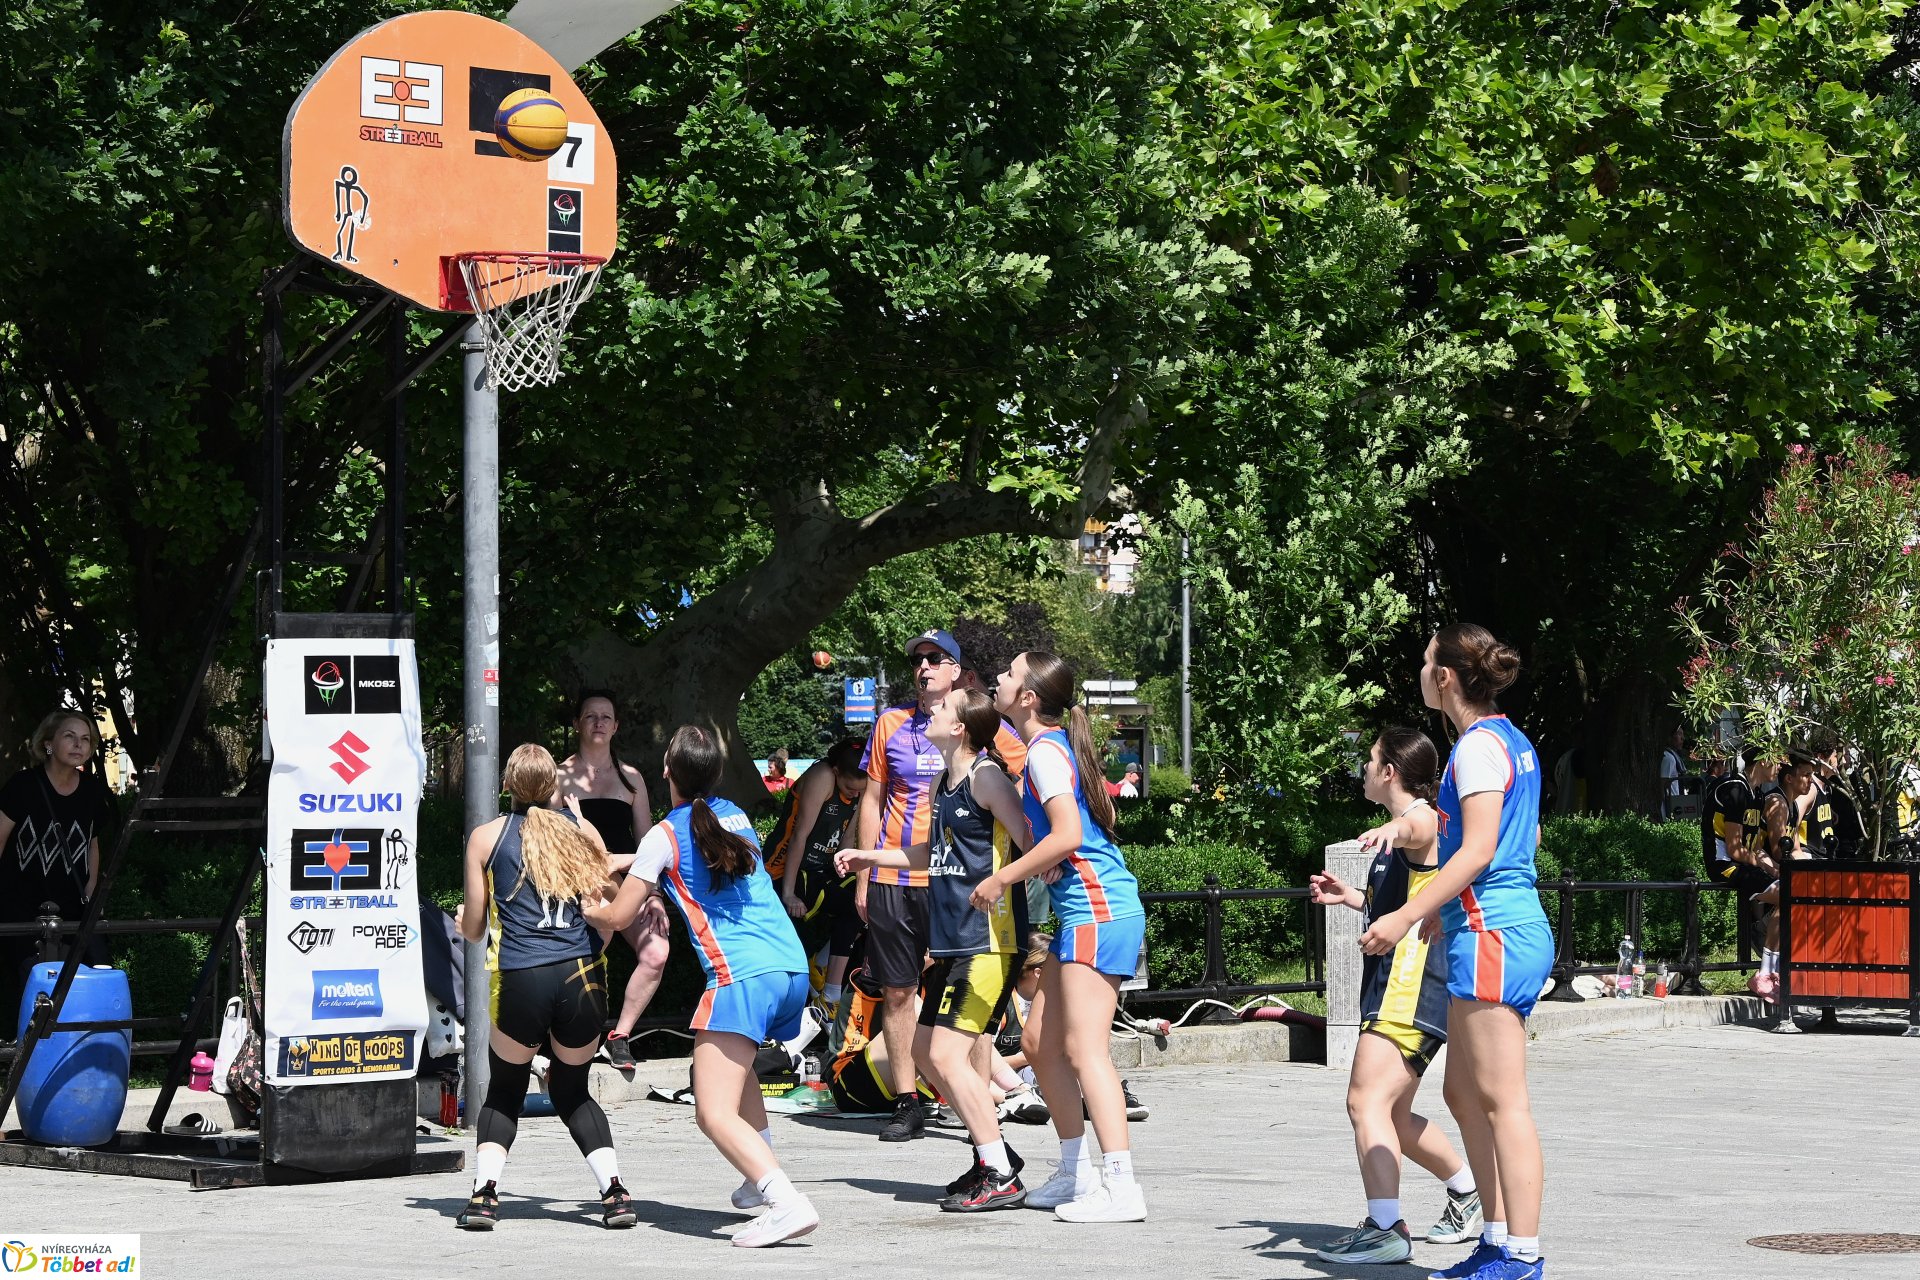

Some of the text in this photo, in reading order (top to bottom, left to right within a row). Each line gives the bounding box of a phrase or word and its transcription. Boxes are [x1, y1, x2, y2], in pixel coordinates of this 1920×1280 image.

[360, 125, 443, 148] STREETBALL
[358, 680, 396, 688] MKOSZ
[299, 793, 402, 813] SUZUKI
[928, 865, 966, 877] REETBALL
[290, 895, 398, 909] STREETBALL
[298, 928, 335, 947] TOTI
[353, 924, 408, 937] POWER
[375, 937, 406, 949] ADE
[321, 982, 375, 998] molten
[319, 998, 376, 1008] For the real game
[938, 985, 956, 1015] 6
[311, 1040, 404, 1059] KING OF HOOPS
[312, 1067, 335, 1076] SPORTS
[335, 1066, 356, 1074] CARDS
[362, 1063, 401, 1073] MEMORABILIA
